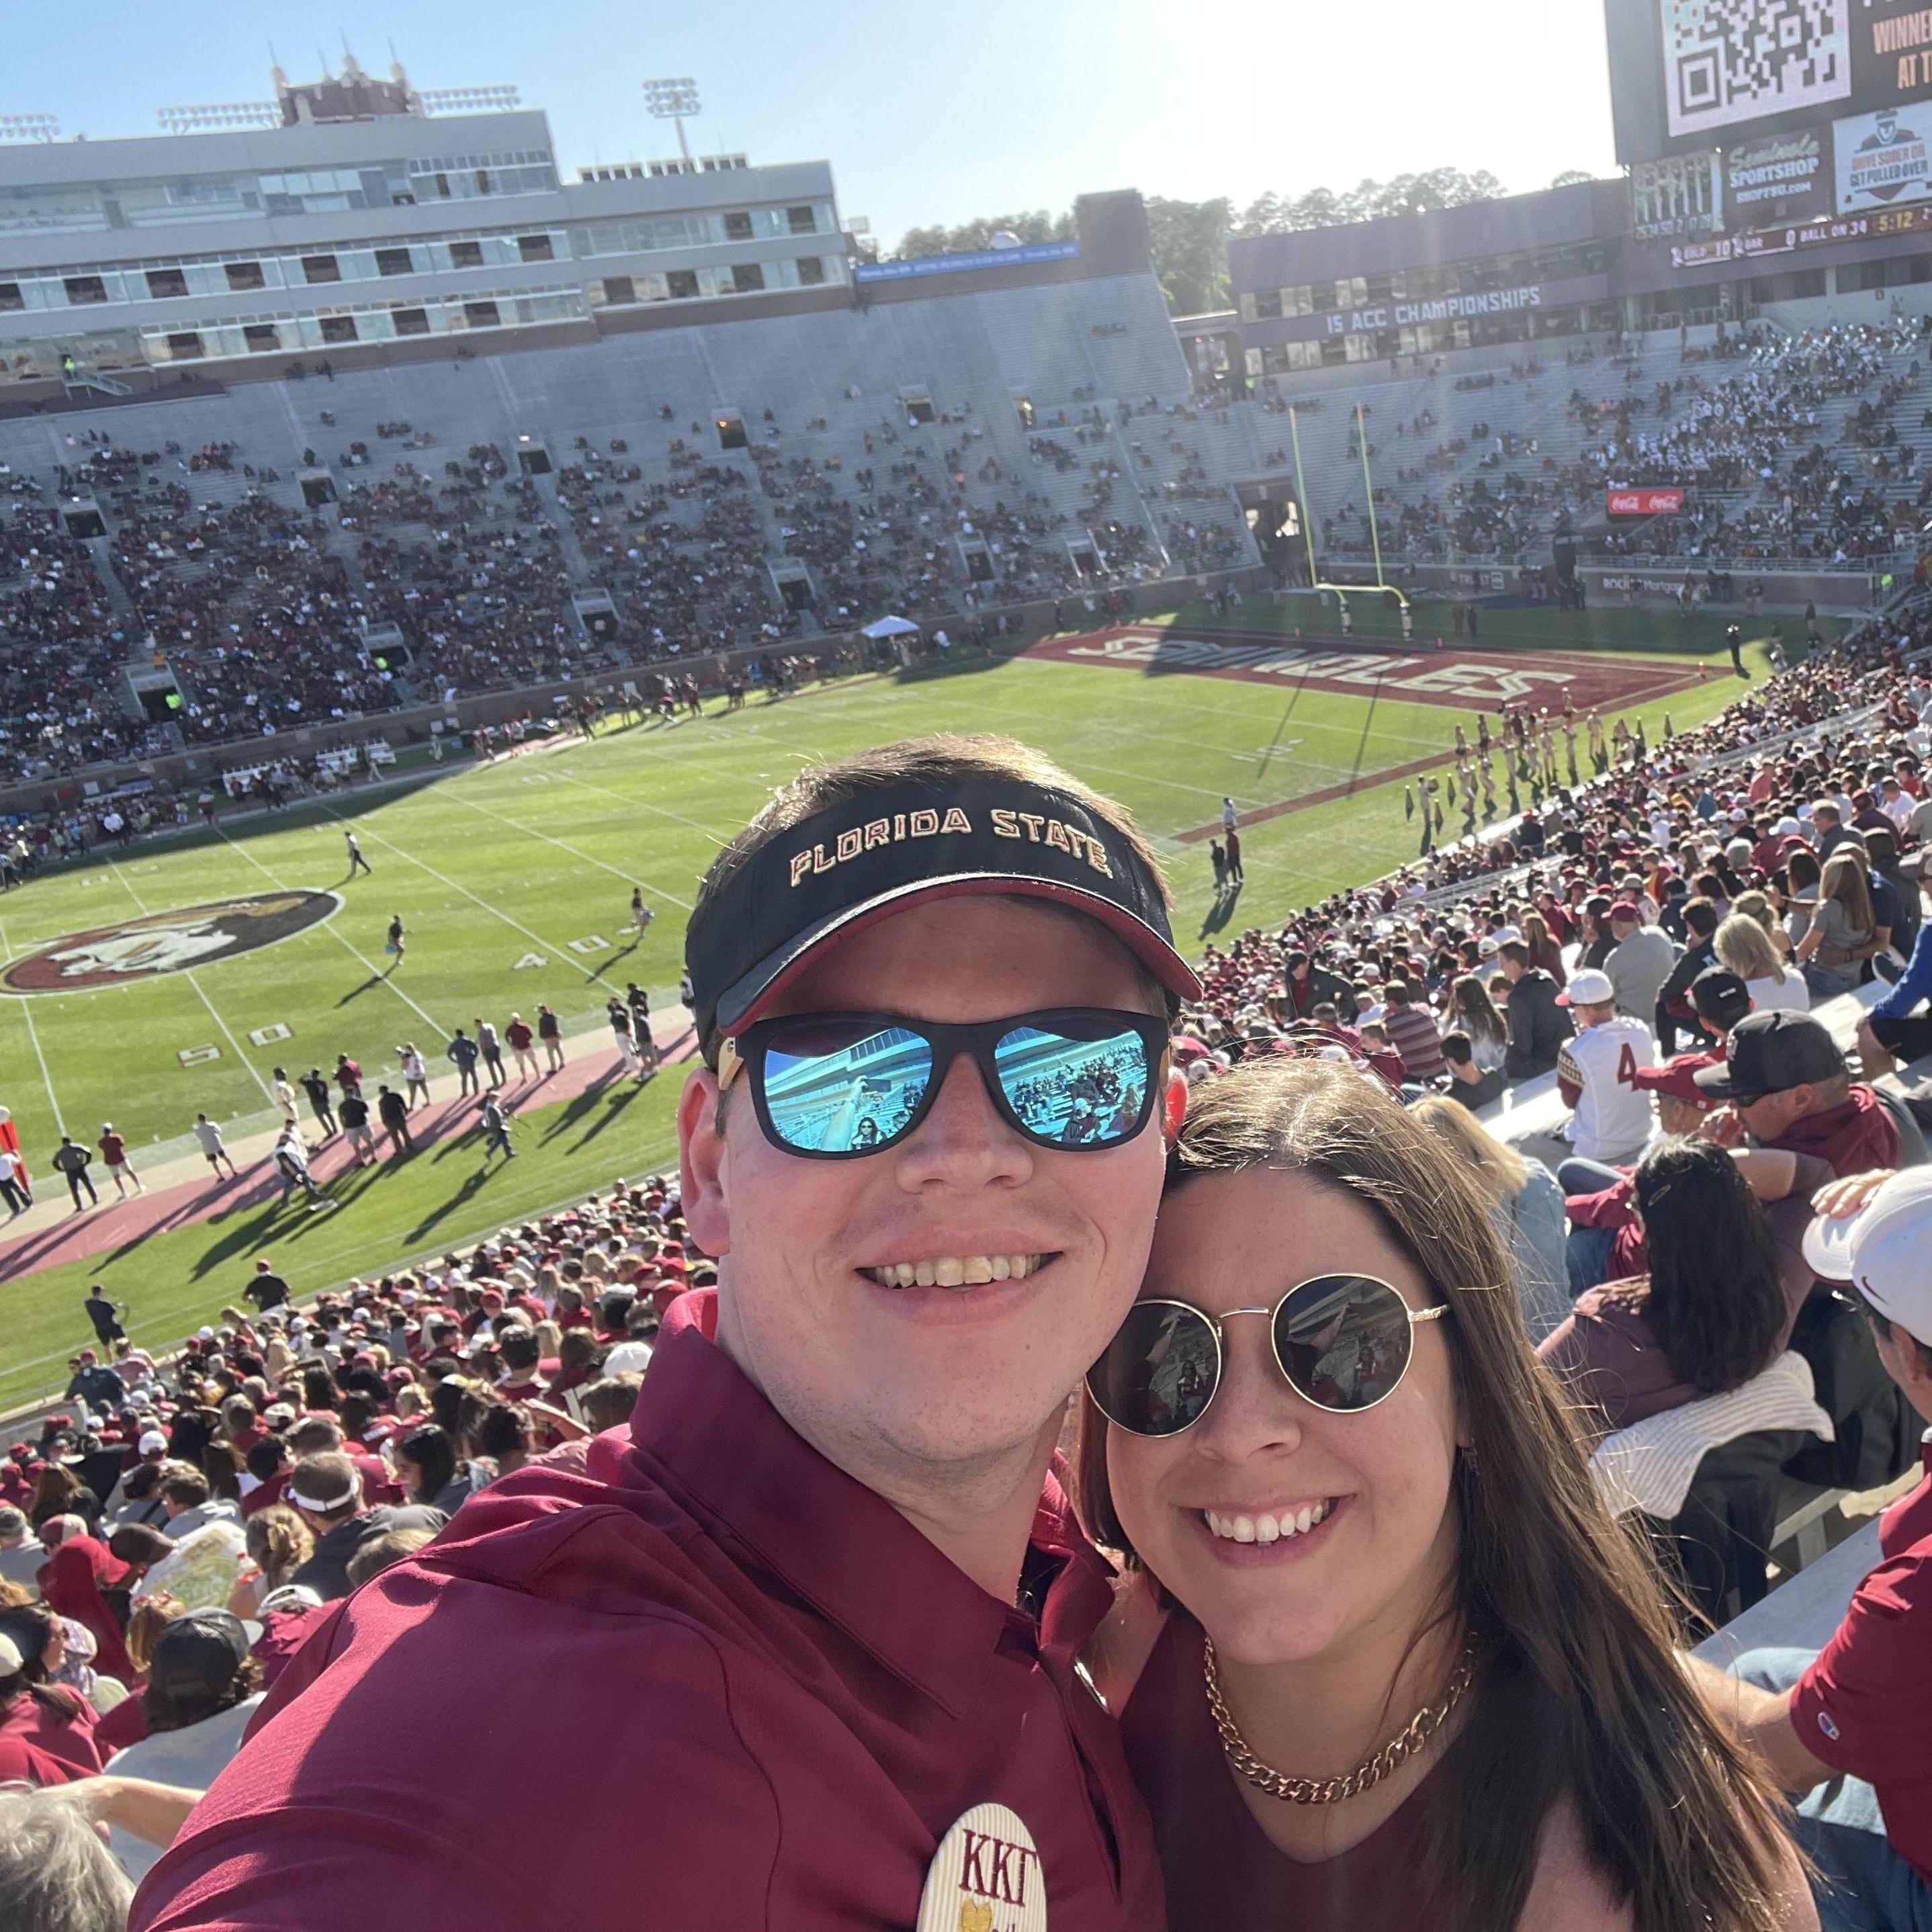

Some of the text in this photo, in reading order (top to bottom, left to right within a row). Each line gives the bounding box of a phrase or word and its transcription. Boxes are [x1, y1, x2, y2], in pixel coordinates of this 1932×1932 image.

[1897, 54, 1917, 89] AT
[1730, 157, 1819, 188] SPORTSHOP
[1800, 228, 1827, 243] BALL
[1831, 224, 1847, 237] ON
[1880, 211, 1914, 232] 5:12
[1326, 287, 1541, 334] 15 ACC CHAMPIONSHIPS
[789, 807, 1110, 888] FLORIDA STATE
[1617, 1042, 1639, 1092] 4
